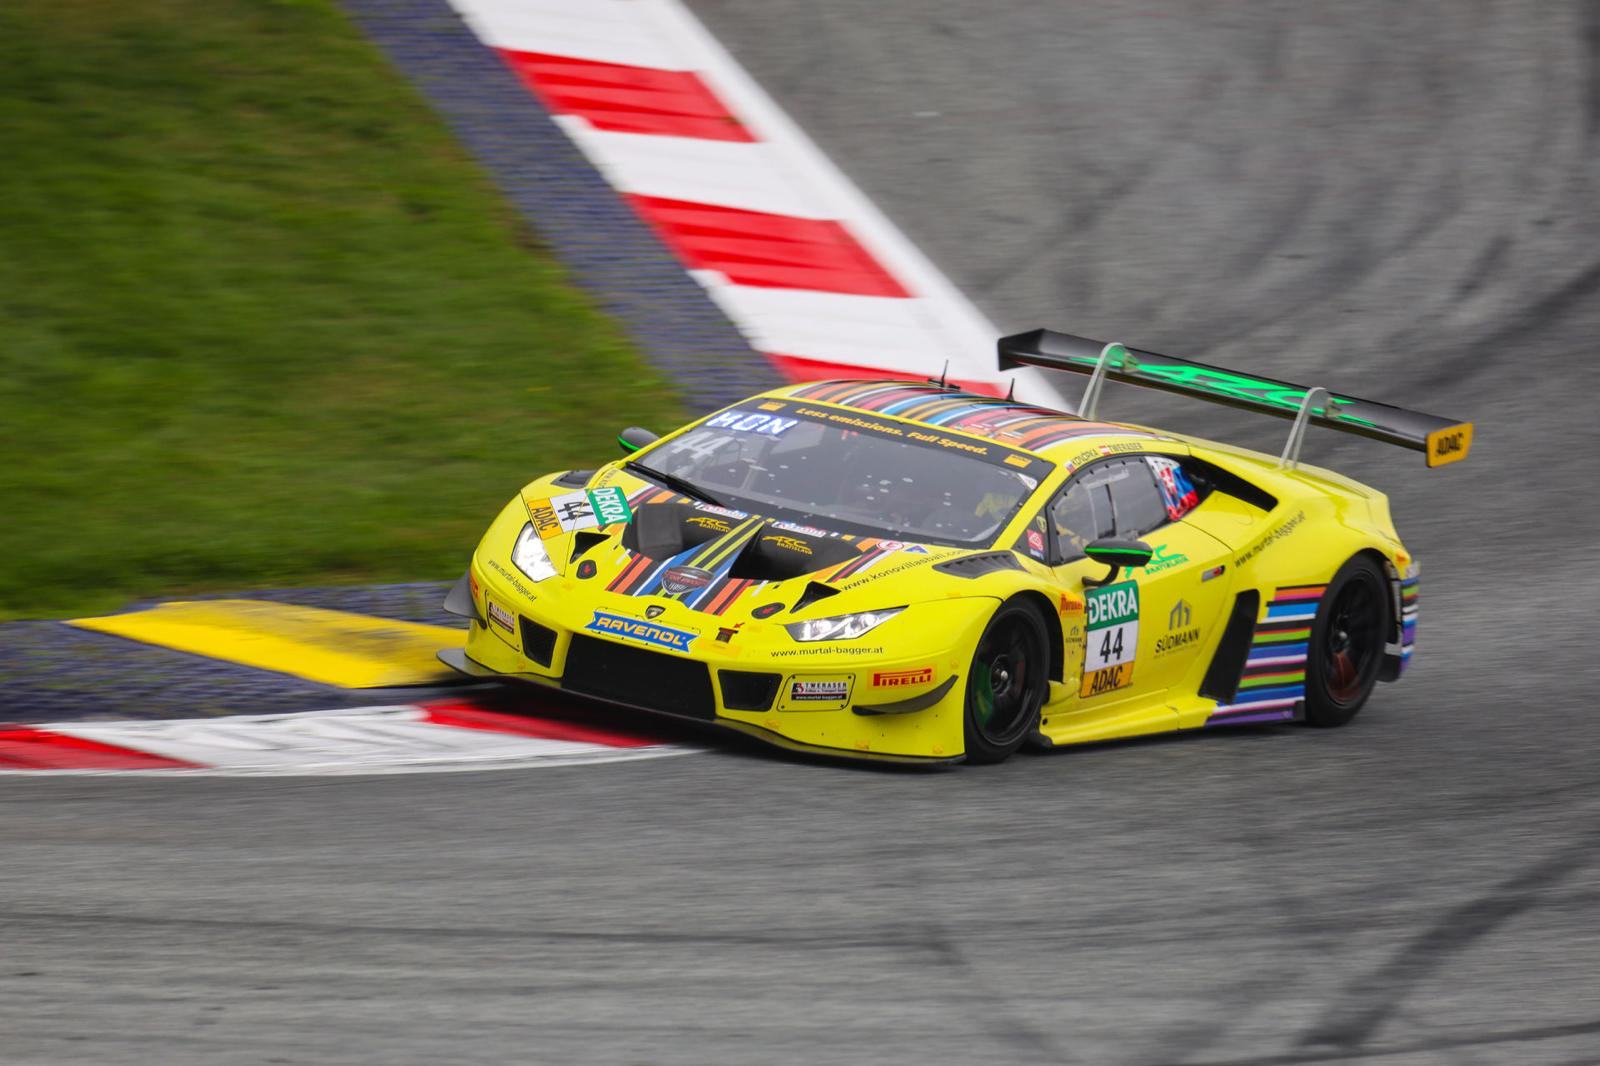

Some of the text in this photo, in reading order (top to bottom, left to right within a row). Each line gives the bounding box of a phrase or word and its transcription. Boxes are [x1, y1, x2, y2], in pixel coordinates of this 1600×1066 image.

[705, 411, 799, 435] KON
[795, 407, 988, 456] Less emissions. Full Speed.
[672, 431, 736, 459] 44
[1435, 432, 1465, 457] ADAC
[531, 506, 560, 532] ADAC
[557, 501, 594, 522] 44
[592, 487, 628, 524] DEKRA
[1087, 587, 1138, 624] DEKRA
[596, 616, 685, 646] RAVENOL
[1099, 627, 1124, 663] 44
[770, 645, 884, 658] www.murtal-bagger.at
[872, 668, 932, 687] PIRELLI
[1090, 666, 1124, 694] ADAC
